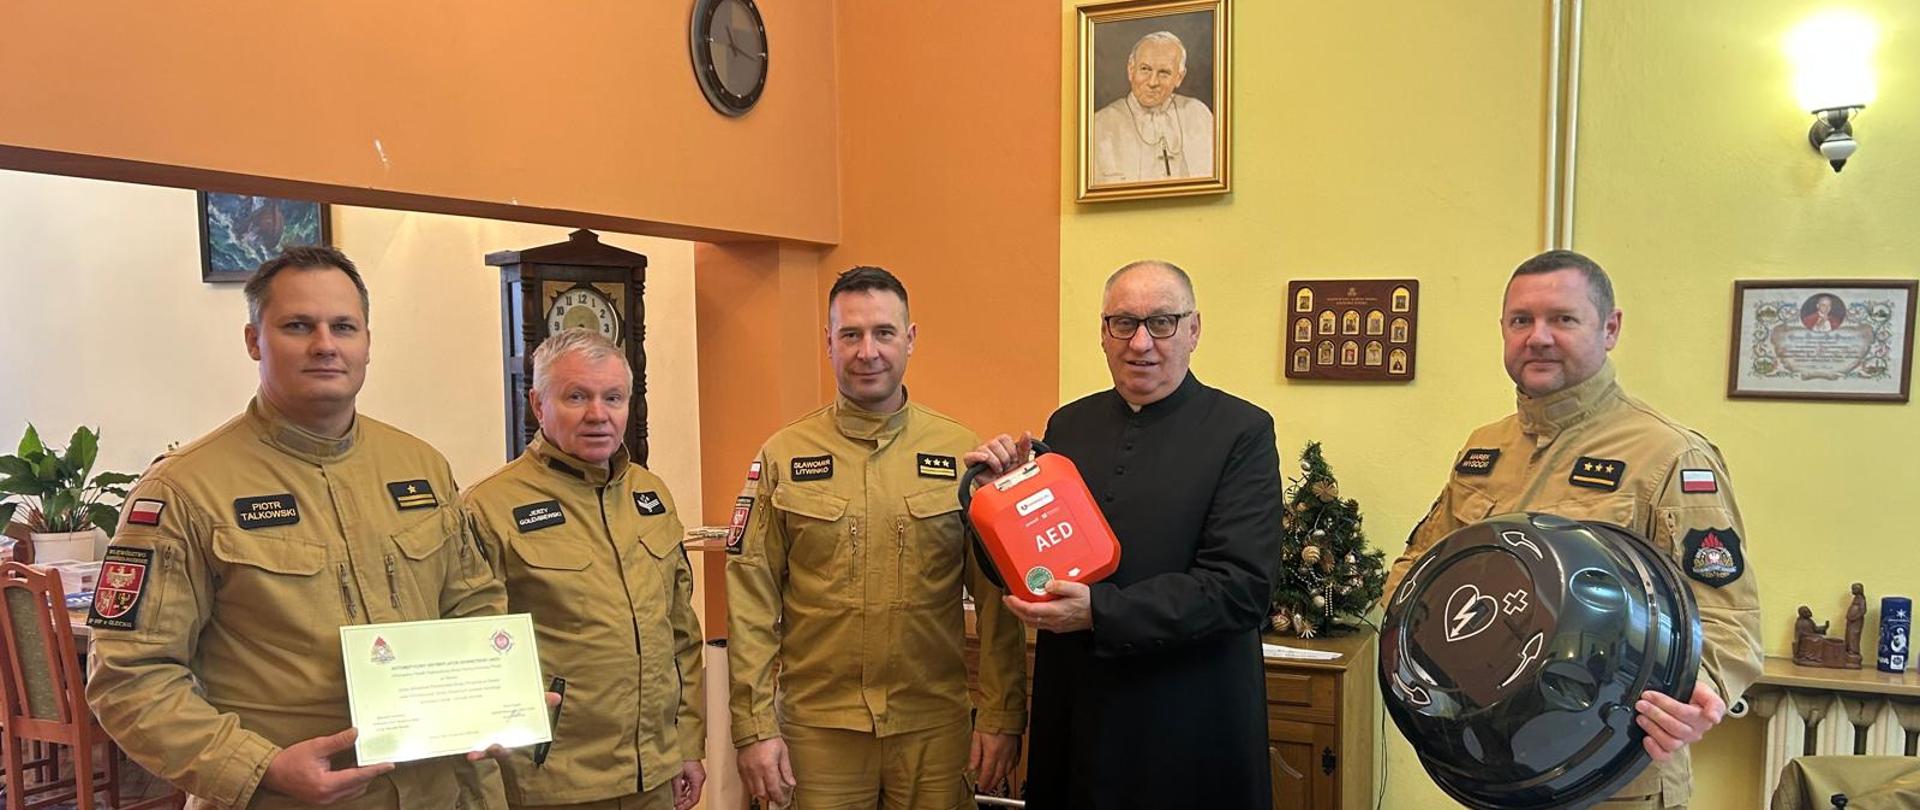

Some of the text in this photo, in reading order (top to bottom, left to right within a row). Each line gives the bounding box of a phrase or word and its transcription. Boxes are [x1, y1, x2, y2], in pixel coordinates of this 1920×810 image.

[566, 296, 572, 306] 11
[578, 294, 587, 304] 12
[591, 298, 596, 308] 1
[556, 306, 564, 316] 10
[600, 309, 605, 318] 2
[554, 321, 560, 331] 9
[604, 323, 610, 333] 3
[251, 501, 282, 511] PIOTR
[240, 508, 297, 521] TALKOWSKI
[529, 508, 548, 517] JERZY
[1035, 521, 1074, 553] AED
